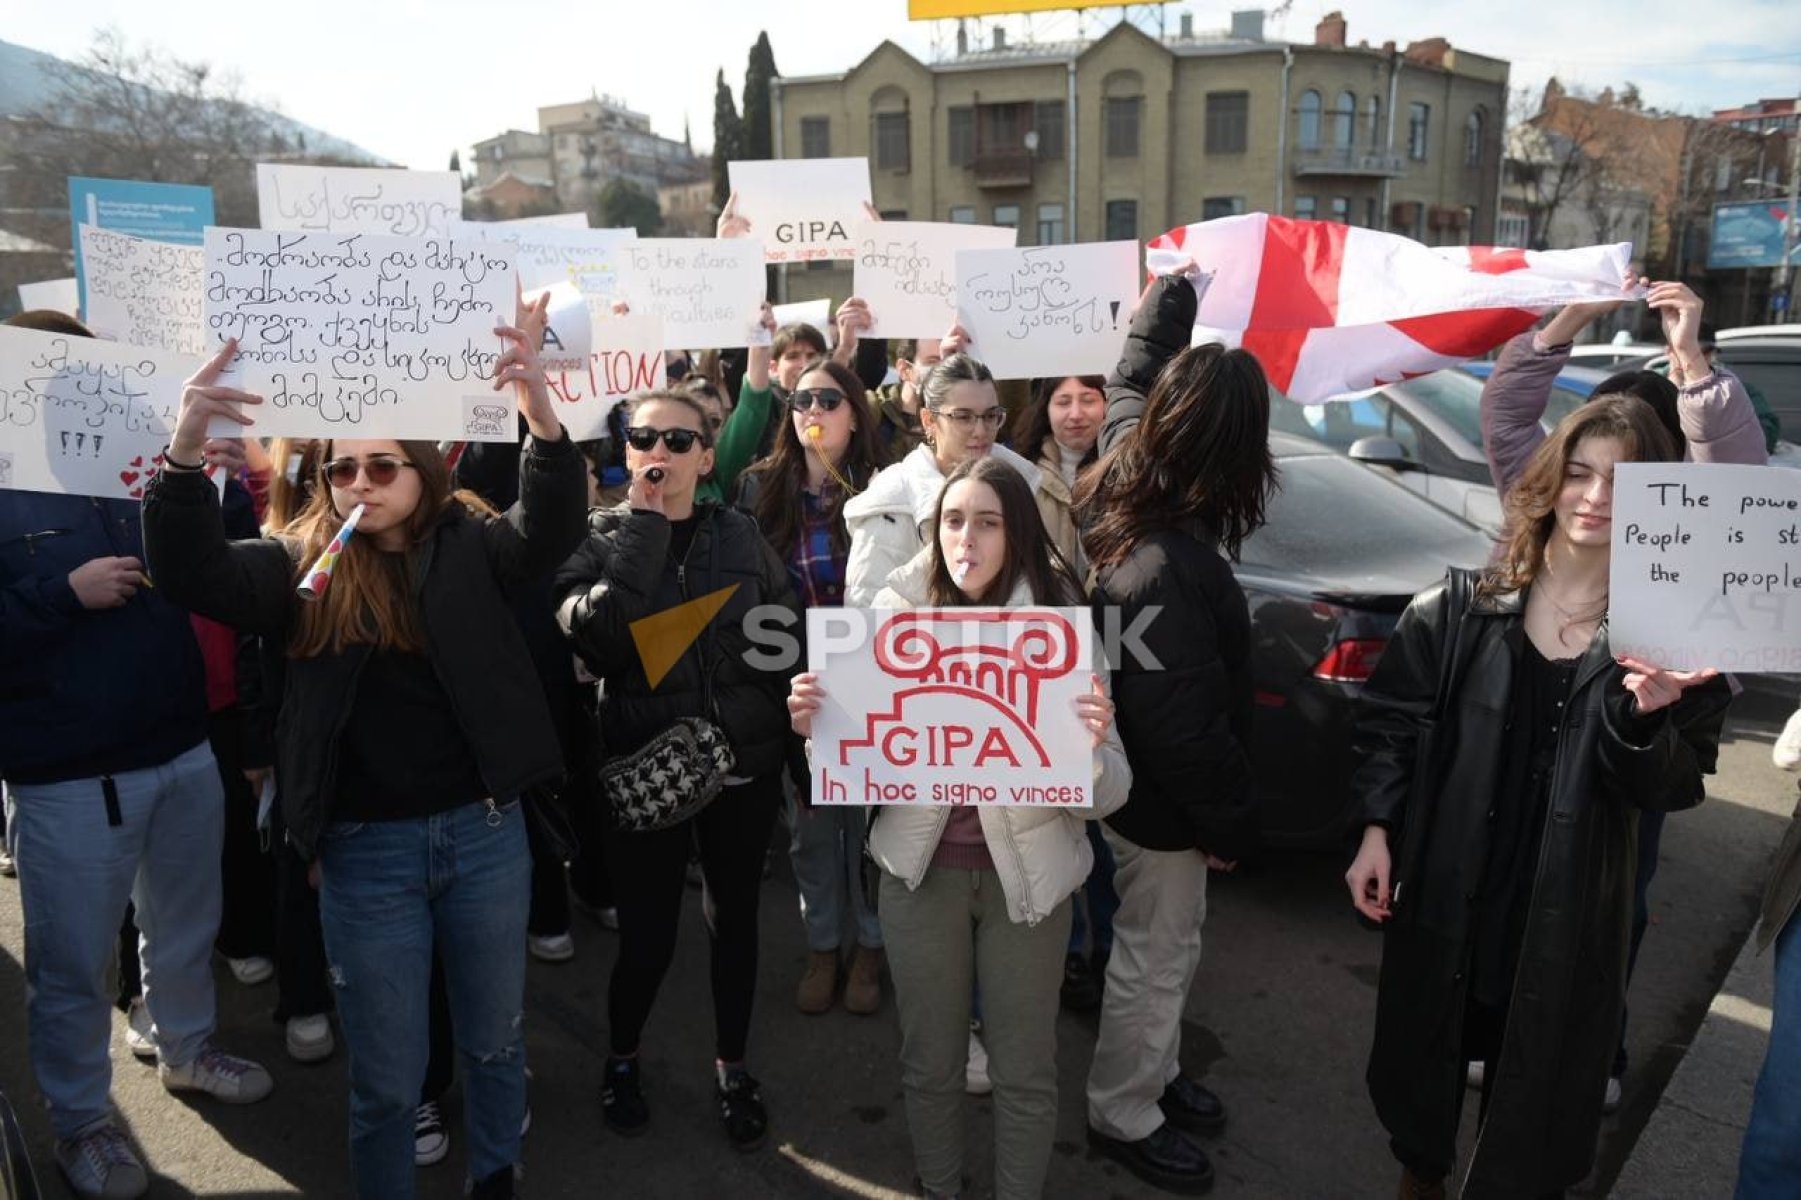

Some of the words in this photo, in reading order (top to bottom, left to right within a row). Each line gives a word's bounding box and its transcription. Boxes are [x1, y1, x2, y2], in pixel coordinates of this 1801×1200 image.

[775, 220, 848, 243] GIPA
[380, 250, 418, 282] და
[624, 247, 650, 270] To
[656, 248, 687, 270] the
[691, 248, 739, 270] stars
[1018, 247, 1066, 277] არა
[431, 281, 494, 325] ჩემო
[648, 274, 713, 303] through
[966, 272, 1080, 312] რუსულ
[331, 350, 376, 381] და
[1646, 483, 1710, 507] The
[1625, 522, 1692, 553] People
[1728, 526, 1744, 544] is
[1650, 562, 1681, 584] the
[881, 725, 1021, 767] GIPA
[822, 767, 847, 802] In
[864, 767, 917, 802] hoc
[932, 782, 997, 806] signo
[1009, 782, 1084, 804] vinces
